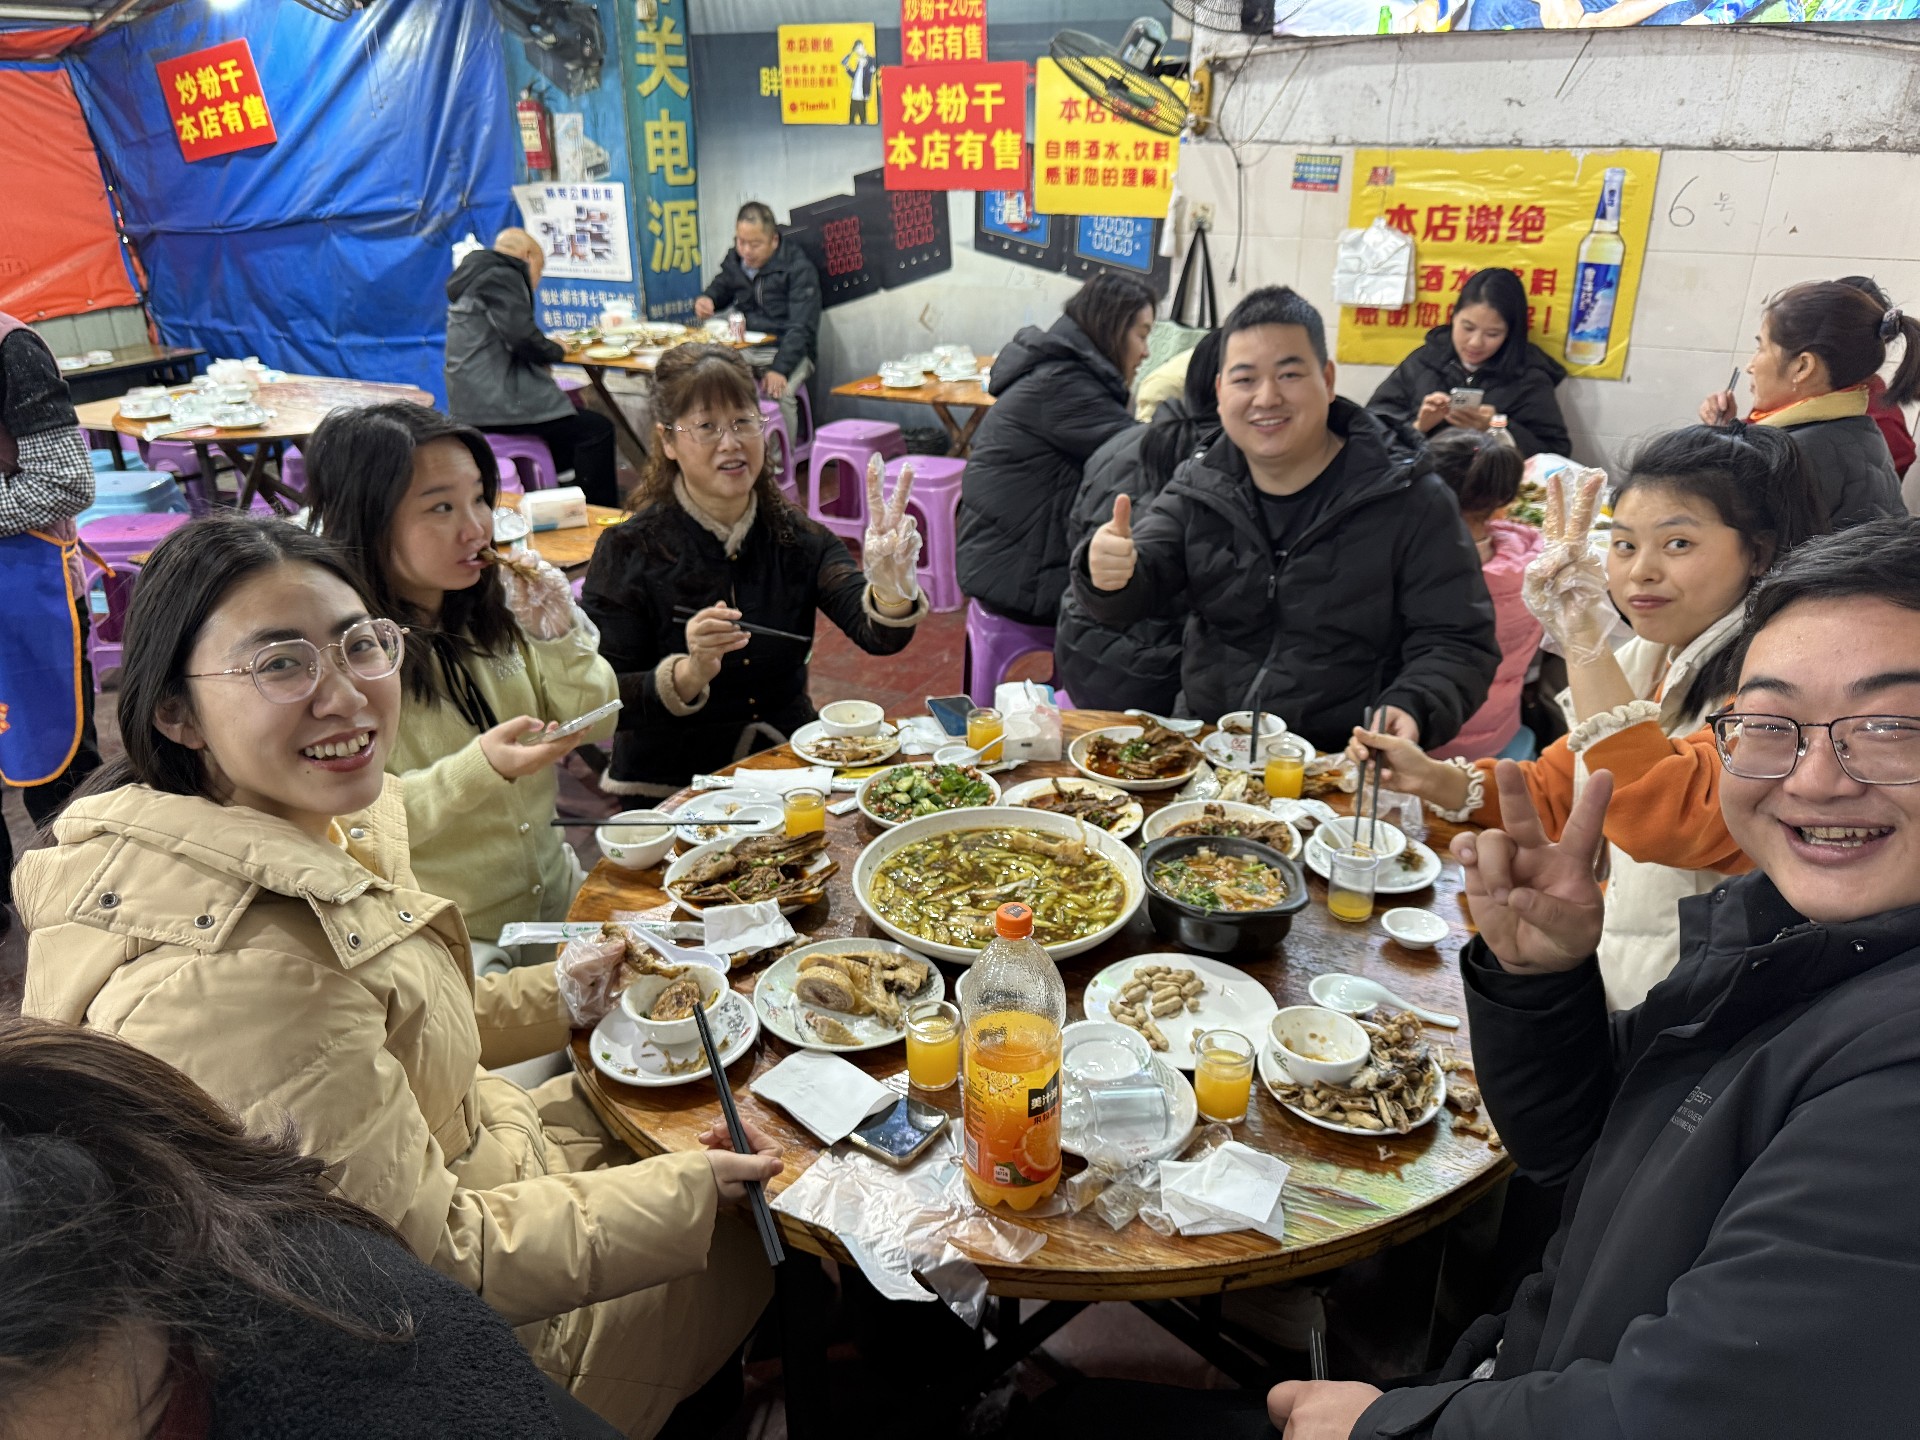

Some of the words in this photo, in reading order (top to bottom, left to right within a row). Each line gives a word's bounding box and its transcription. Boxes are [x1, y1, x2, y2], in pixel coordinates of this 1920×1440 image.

[906, 24, 983, 61] 本店有售
[175, 59, 243, 106] 炒粉干
[901, 83, 1005, 125] 炒粉干
[177, 94, 268, 144] 本店有售
[635, 0, 701, 273] 关电源
[887, 128, 1022, 171] 本店有售
[1385, 204, 1546, 243] 本店谢绝
